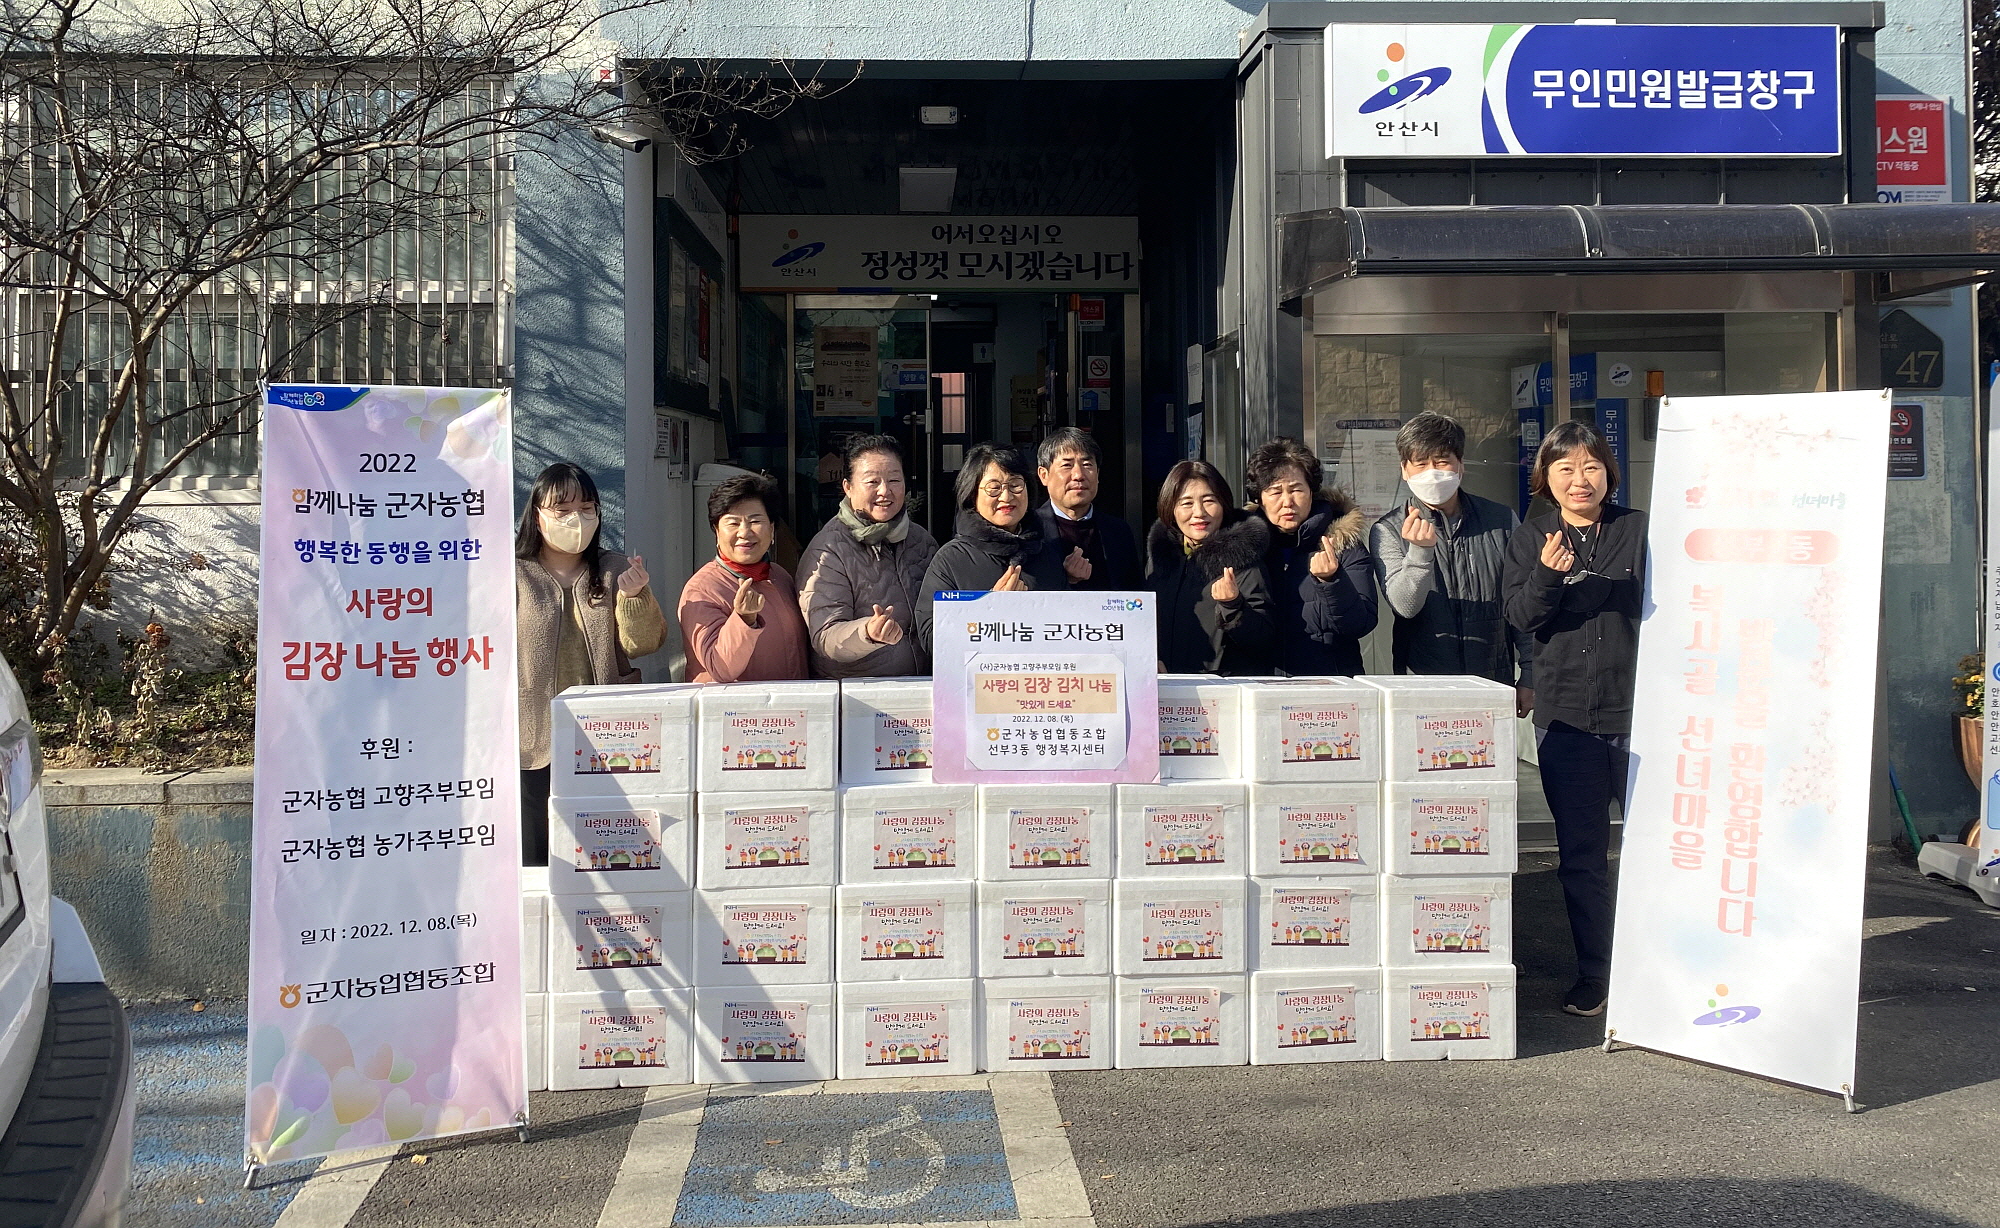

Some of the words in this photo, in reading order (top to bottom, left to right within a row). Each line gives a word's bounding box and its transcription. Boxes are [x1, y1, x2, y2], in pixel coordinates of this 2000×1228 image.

[1532, 68, 1816, 110] 무인민원발급창구
[1374, 120, 1439, 138] 안산시
[1895, 161, 1919, 171] 작동중
[931, 224, 1063, 246] 어서오십시오
[861, 251, 949, 281] 정성껏
[957, 251, 1135, 282] 모시겠습니다
[781, 267, 817, 276] 안산시
[1896, 351, 1940, 384] 47
[359, 454, 417, 473] 2022
[292, 488, 378, 518] 함께나눔
[384, 489, 485, 519] 군자농협
[293, 539, 361, 565] 행복한
[366, 540, 433, 565] 동행을
[437, 538, 483, 562] 위한
[346, 587, 433, 619] 사랑의
[967, 622, 1035, 642] 함께나눔
[1043, 623, 1124, 641] 군자농협
[282, 641, 347, 682] 김장
[356, 639, 420, 679] 나눔
[427, 636, 494, 677] 행사
[980, 663, 1020, 671] (사)군자농협
[1022, 663, 1061, 671] 고향주부모임
[983, 679, 1019, 693] 사랑의
[1024, 677, 1051, 693] 김장
[1057, 677, 1084, 693] 김치
[1089, 680, 1112, 693] 나눔
[1016, 699, 1045, 710] "맛있게
[1047, 699, 1076, 709] 드세요"
[1159, 706, 1173, 715] 랑의
[1012, 715, 1032, 723] 2022.
[1060, 715, 1074, 724] (목)
[1288, 712, 1313, 721] 사랑의
[584, 722, 610, 731] 사랑의
[731, 718, 757, 727] 사랑의
[883, 719, 908, 728] 사랑의
[911, 719, 932, 727] 김장
[1424, 721, 1447, 730] 사랑의
[360, 738, 400, 759] 후원
[988, 744, 1029, 755] 선부3동
[1036, 744, 1105, 755] 행정복지센터
[282, 786, 366, 814] 군자농협
[373, 777, 495, 807] 고향주부모임
[1669, 715, 1714, 871] 선녀마을
[1419, 806, 1443, 814] 사랑의
[733, 817, 759, 826] 사랑의
[882, 817, 907, 826] 사랑의
[1017, 816, 1042, 825] 사랑의
[1152, 814, 1177, 823] 사랑의
[1287, 813, 1311, 821] 사랑의
[584, 818, 610, 828] 사랑의
[281, 834, 366, 863] 군자농협
[373, 824, 496, 857] 농가주부모임
[1717, 742, 1768, 937] 환영합니다
[1280, 896, 1304, 904] 사랑의
[1012, 907, 1037, 916] 사랑의
[1421, 903, 1445, 911] 사랑의
[731, 912, 758, 921] 사랑의
[870, 908, 895, 917] 사랑의
[1150, 909, 1175, 918] 사랑의
[585, 916, 611, 926] 사랑의
[300, 928, 337, 945] 일자
[350, 923, 394, 940] 2022.
[399, 920, 422, 935] 12.
[427, 913, 478, 931] 08.(목)
[305, 962, 496, 1004] 군자농업협동조합
[1148, 995, 1173, 1004] 사랑의
[1418, 992, 1442, 1000] 사랑의
[1284, 997, 1309, 1006] 사랑의
[731, 1010, 757, 1019] 사랑의
[1017, 1008, 1043, 1017] 사랑의
[588, 1016, 615, 1025] 사랑의
[873, 1014, 899, 1023] 사랑의
